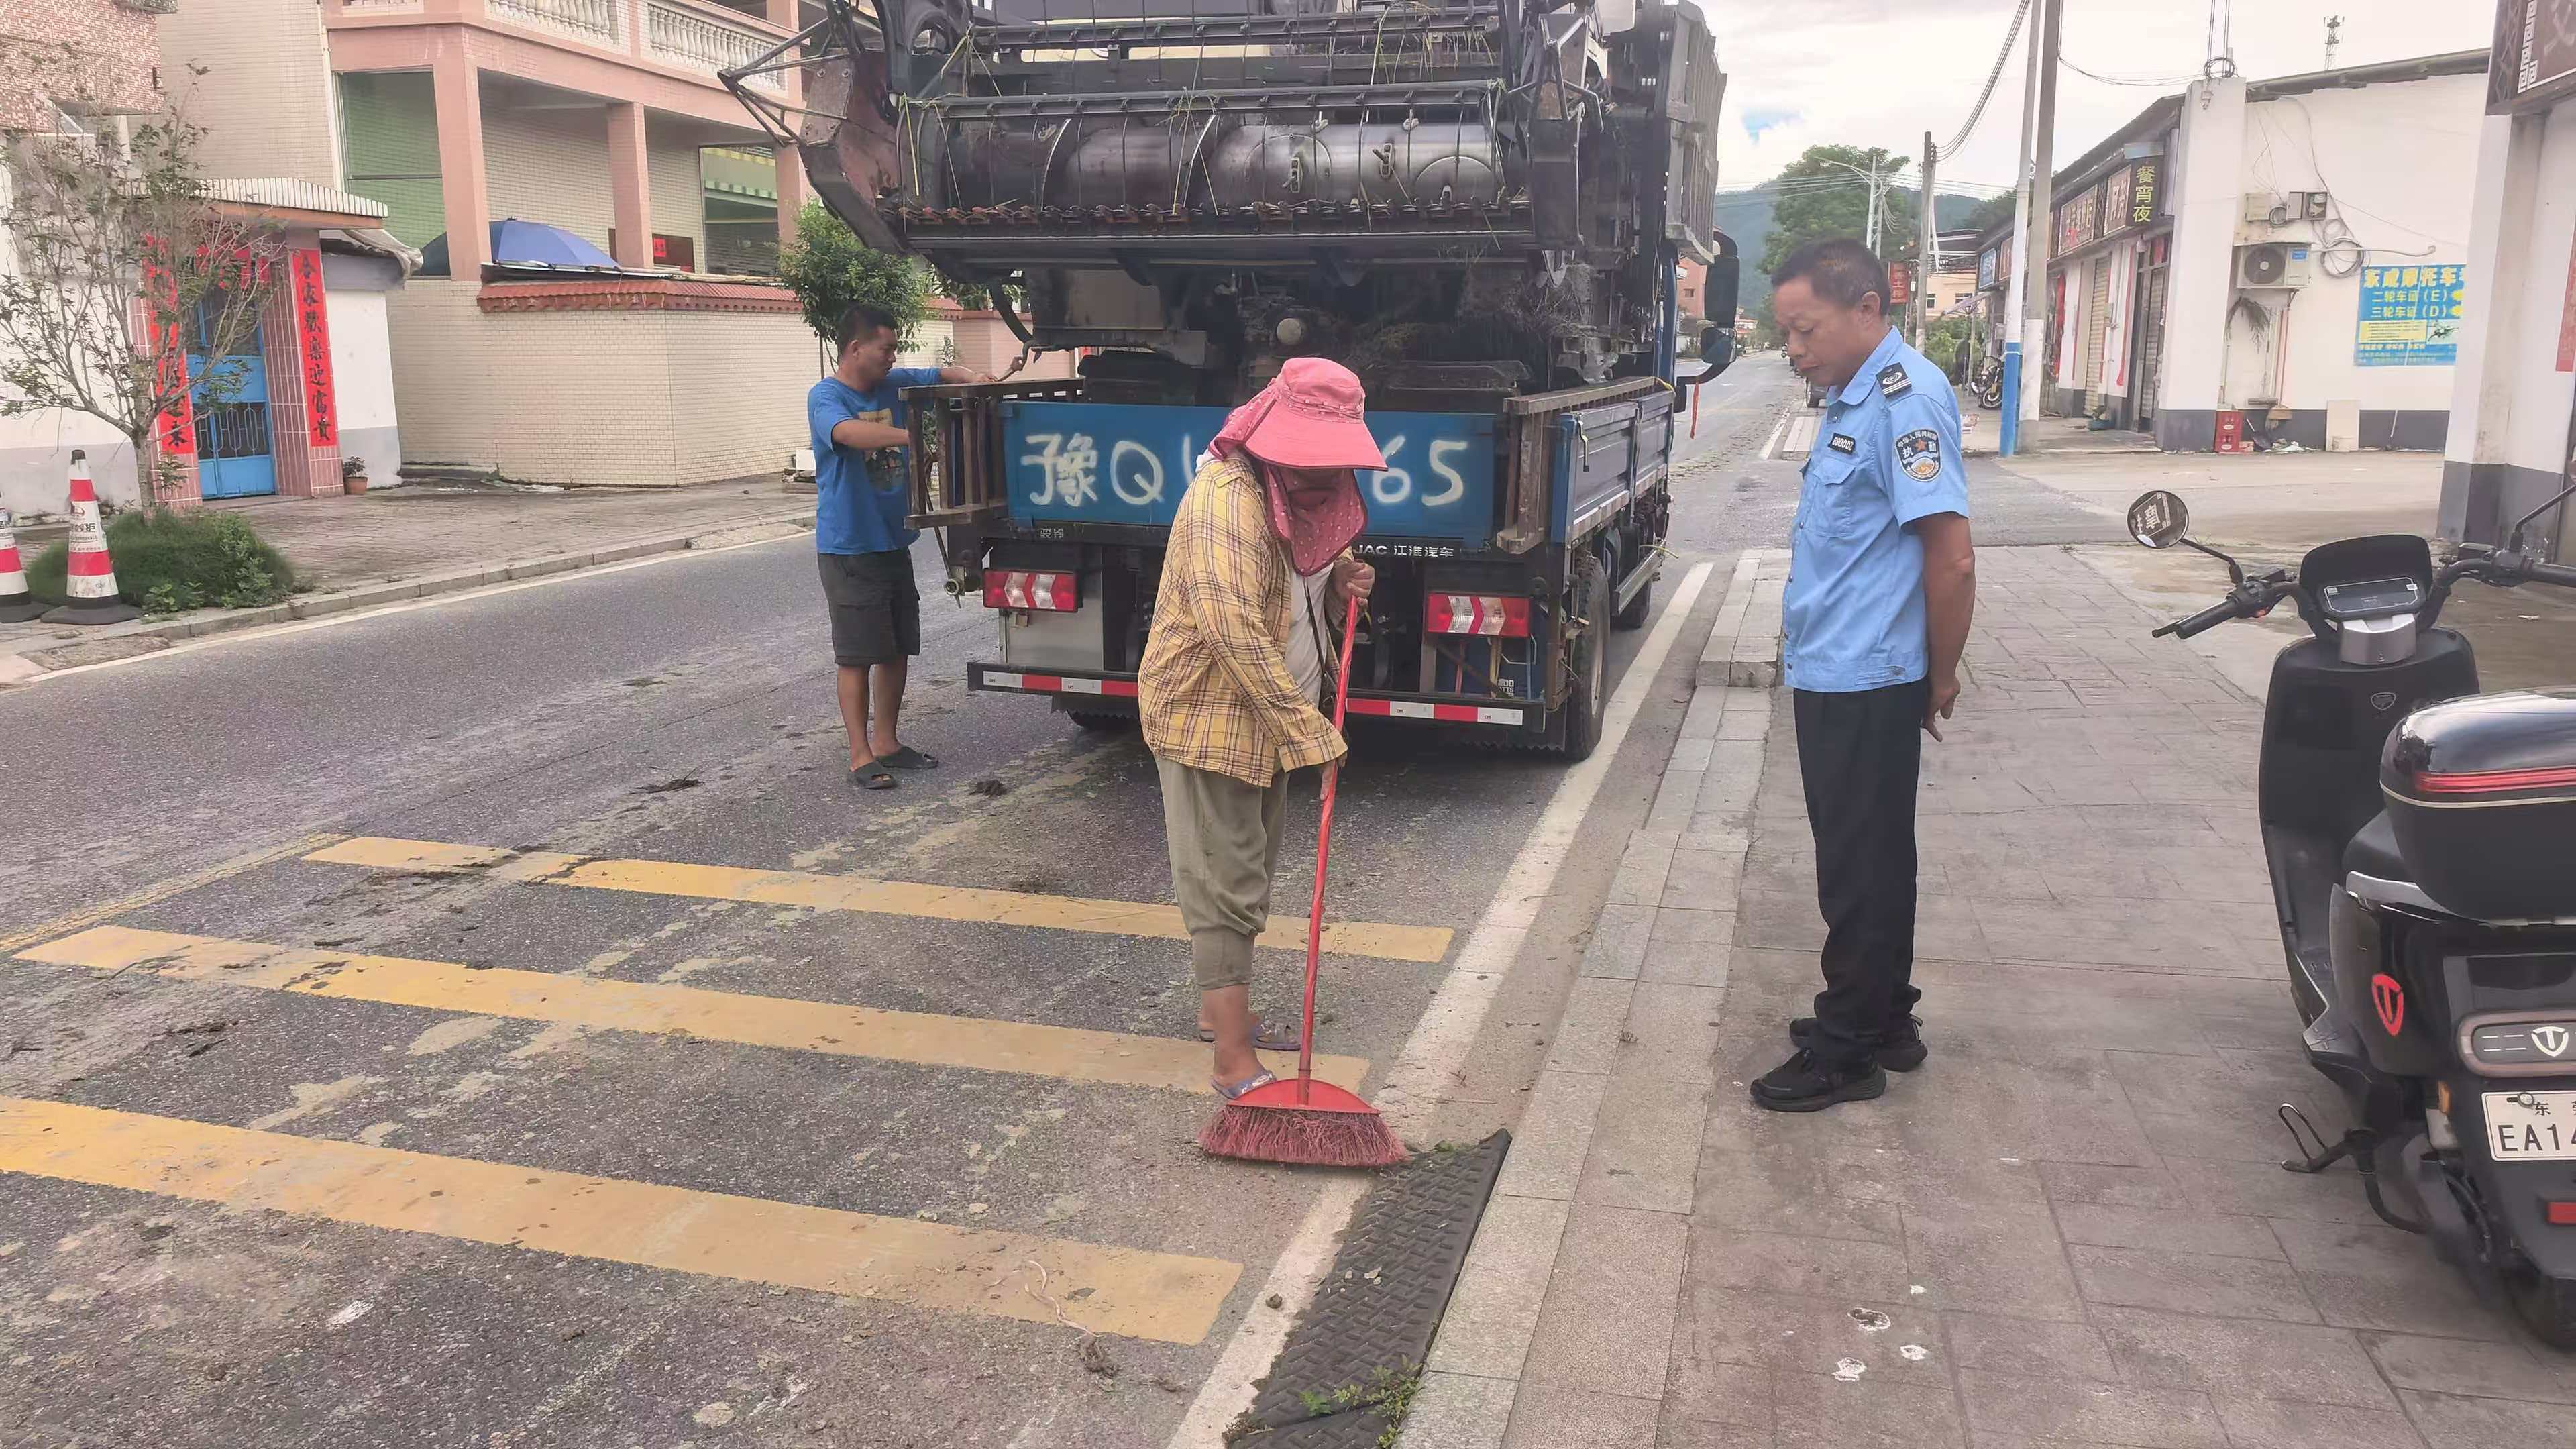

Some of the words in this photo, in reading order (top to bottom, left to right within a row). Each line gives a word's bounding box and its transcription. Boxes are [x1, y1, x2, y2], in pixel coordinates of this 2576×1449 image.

[2133, 166, 2155, 223] 餐宵夜
[2363, 267, 2466, 288] 东成摩托车
[1354, 545, 1387, 555] JAC
[1393, 545, 1454, 557] 江淮汽车
